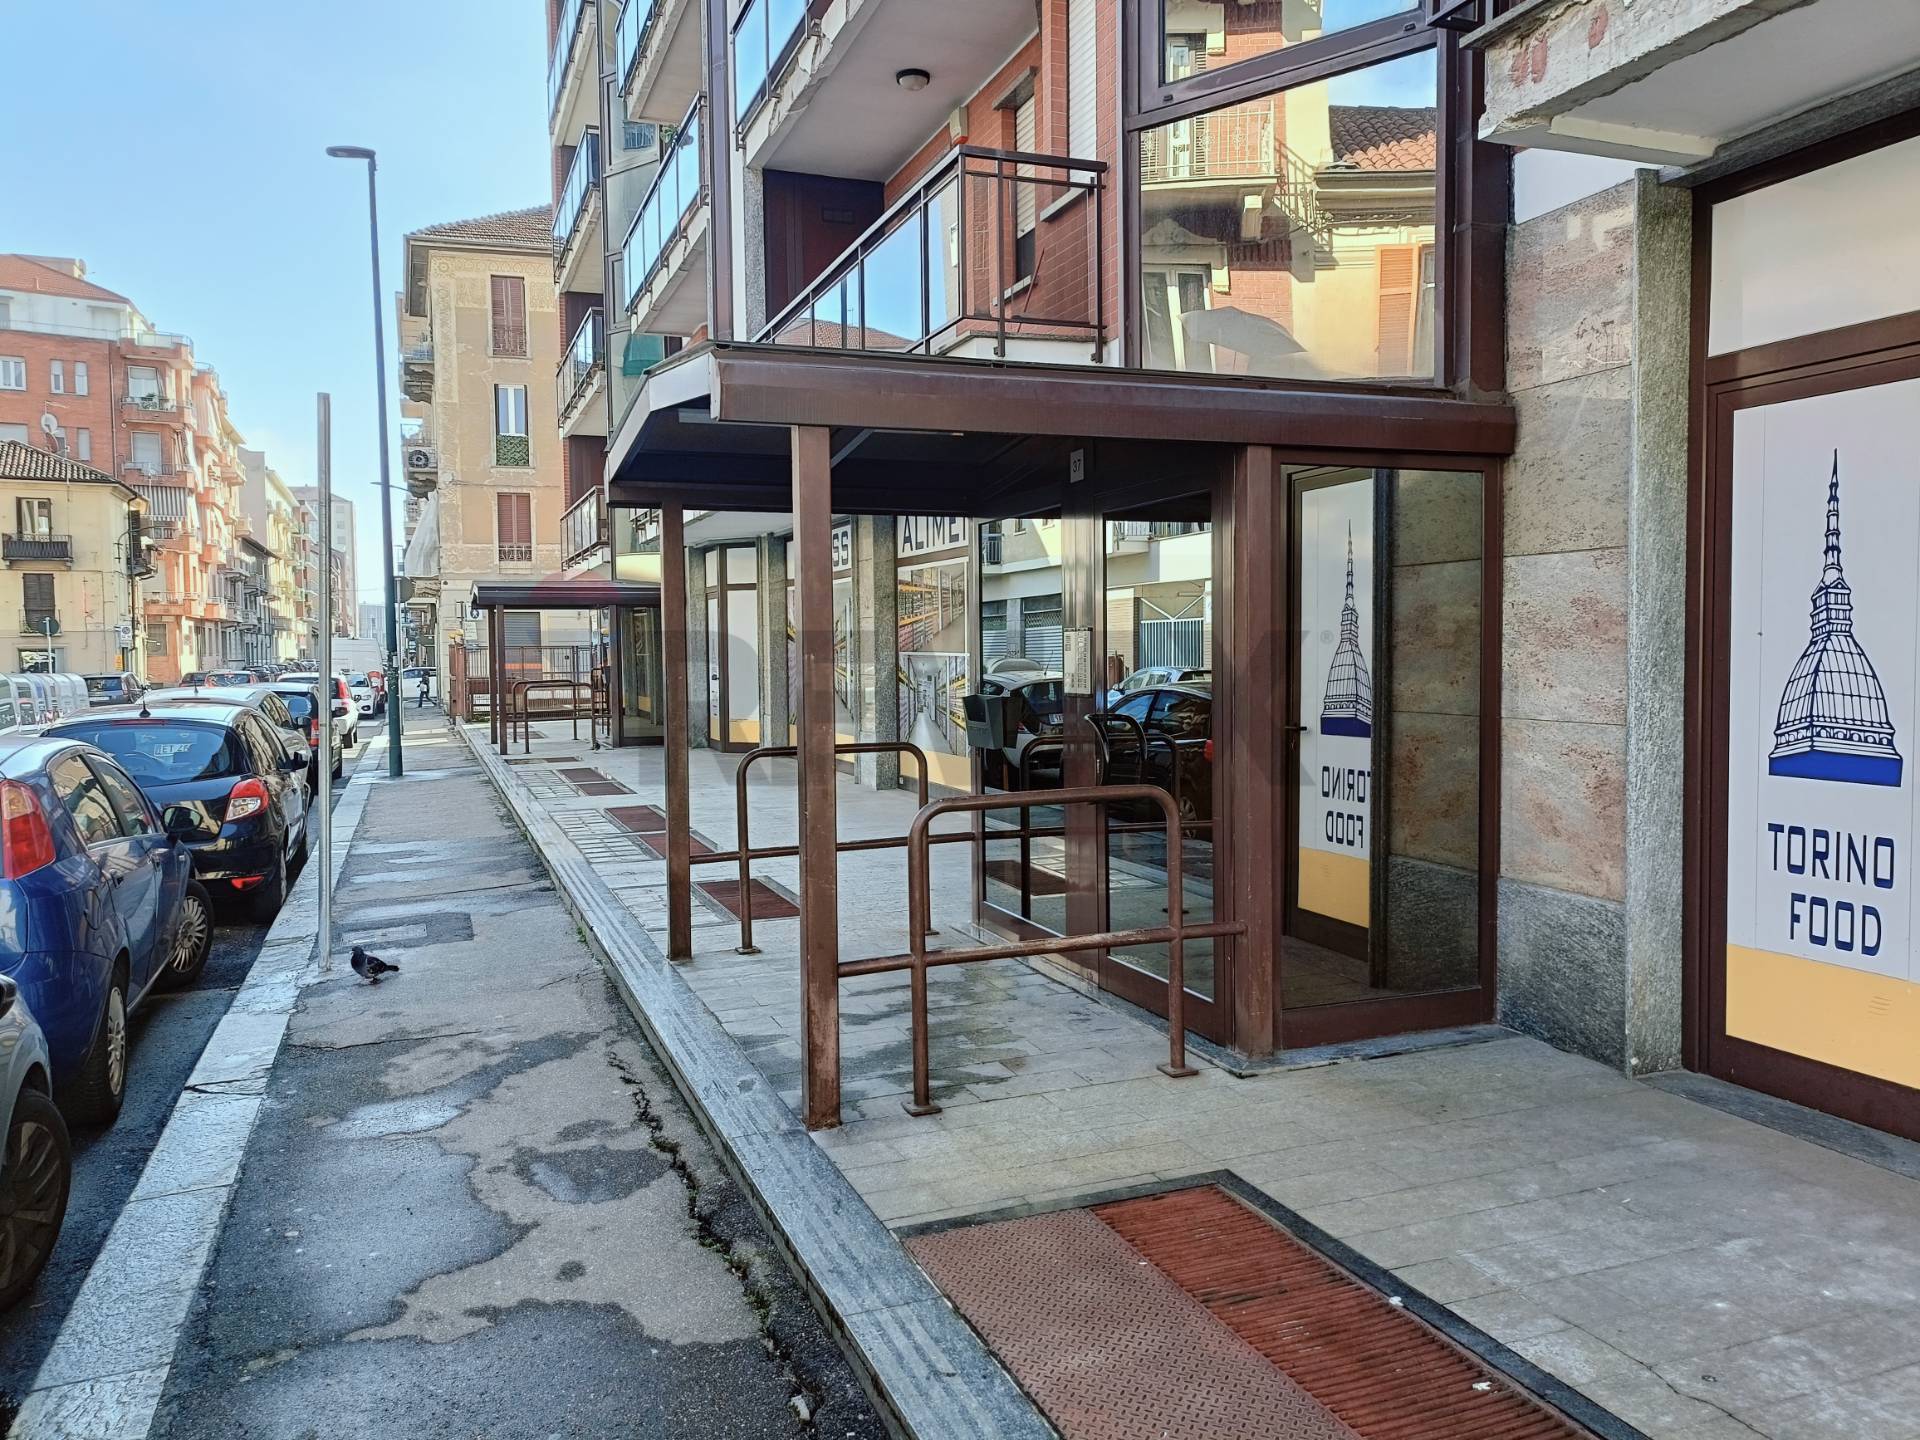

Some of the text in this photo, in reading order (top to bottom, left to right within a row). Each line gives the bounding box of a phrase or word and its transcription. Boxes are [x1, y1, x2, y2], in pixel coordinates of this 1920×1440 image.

[1072, 458, 1081, 473] 37
[902, 515, 966, 552] ALIME
[1767, 822, 1895, 889] TORINO
[1790, 892, 1882, 957] FOOD
